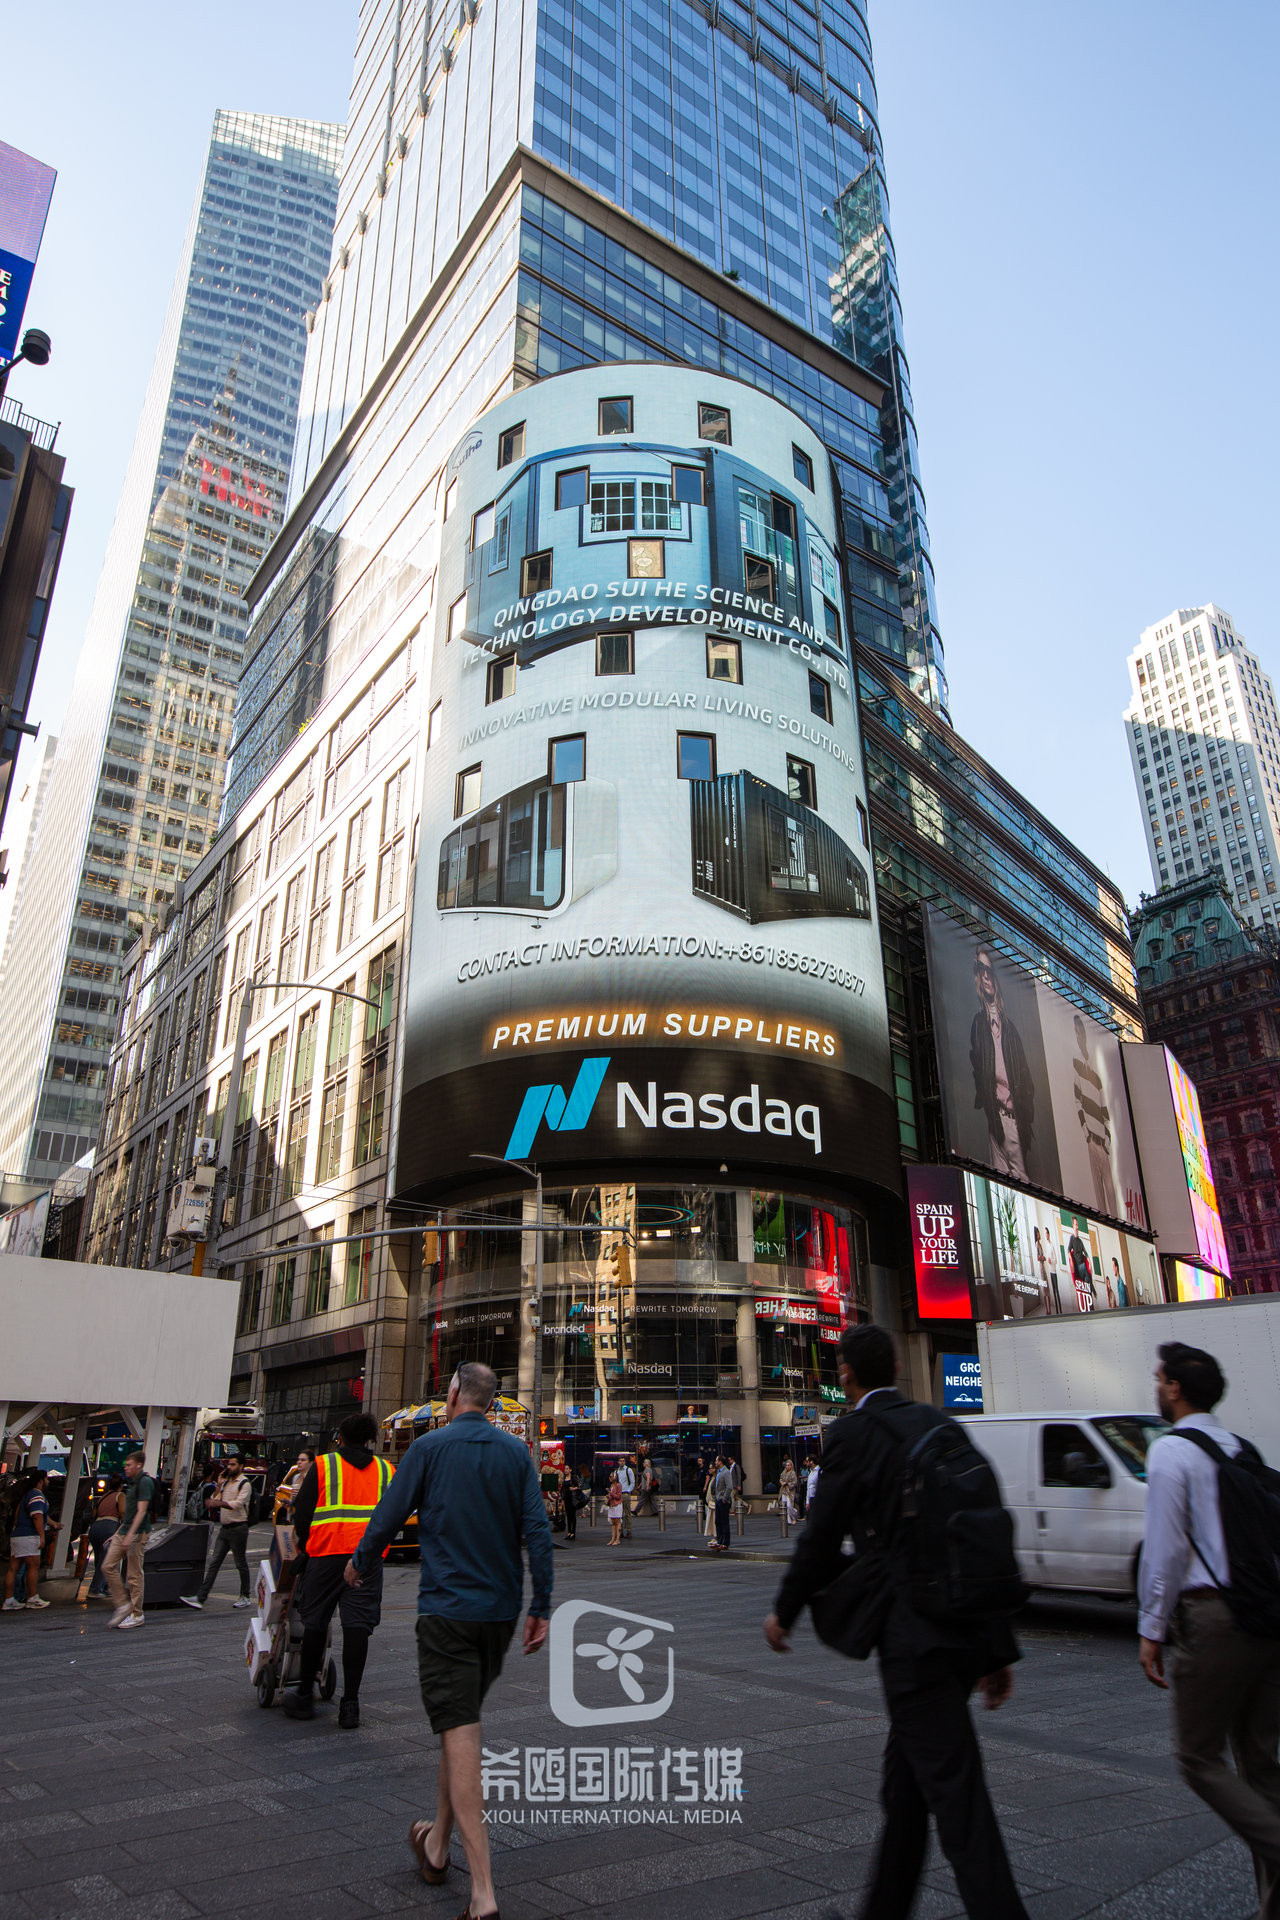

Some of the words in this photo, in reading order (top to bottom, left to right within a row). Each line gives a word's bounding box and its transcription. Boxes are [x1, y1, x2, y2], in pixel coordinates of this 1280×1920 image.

[493, 583, 598, 628] QINGDAO
[605, 581, 647, 598] SUI
[654, 581, 688, 598] HE
[694, 584, 784, 624] SCIENCE
[788, 615, 825, 647] AND
[463, 606, 603, 669] TECHNOLOGY
[609, 605, 784, 646] DEVELOPMENT
[459, 695, 574, 751] INNOVATIVE
[579, 690, 697, 710] MODULAR
[704, 694, 773, 724] LIVING
[777, 714, 855, 772] SOLUTIONS
[457, 943, 548, 982] CONTACT
[492, 1012, 647, 1049] PREMIUM
[663, 1013, 836, 1056] SUPPLIERS
[616, 1081, 823, 1155] Nasdaq
[916, 1203, 953, 1215] SPAIN
[917, 1215, 954, 1237] UP
[919, 1238, 957, 1249] YOUR
[920, 1249, 959, 1264] LIFE
[1075, 1279, 1092, 1293] SPAIN
[584, 1304, 615, 1314] Nasdaq
[630, 1305, 667, 1313] REWRITE
[671, 1305, 718, 1314] TOMORROW
[1077, 1291, 1093, 1312] UP
[477, 1311, 512, 1322] TOMORROW
[628, 1363, 672, 1376] Nasdaq
